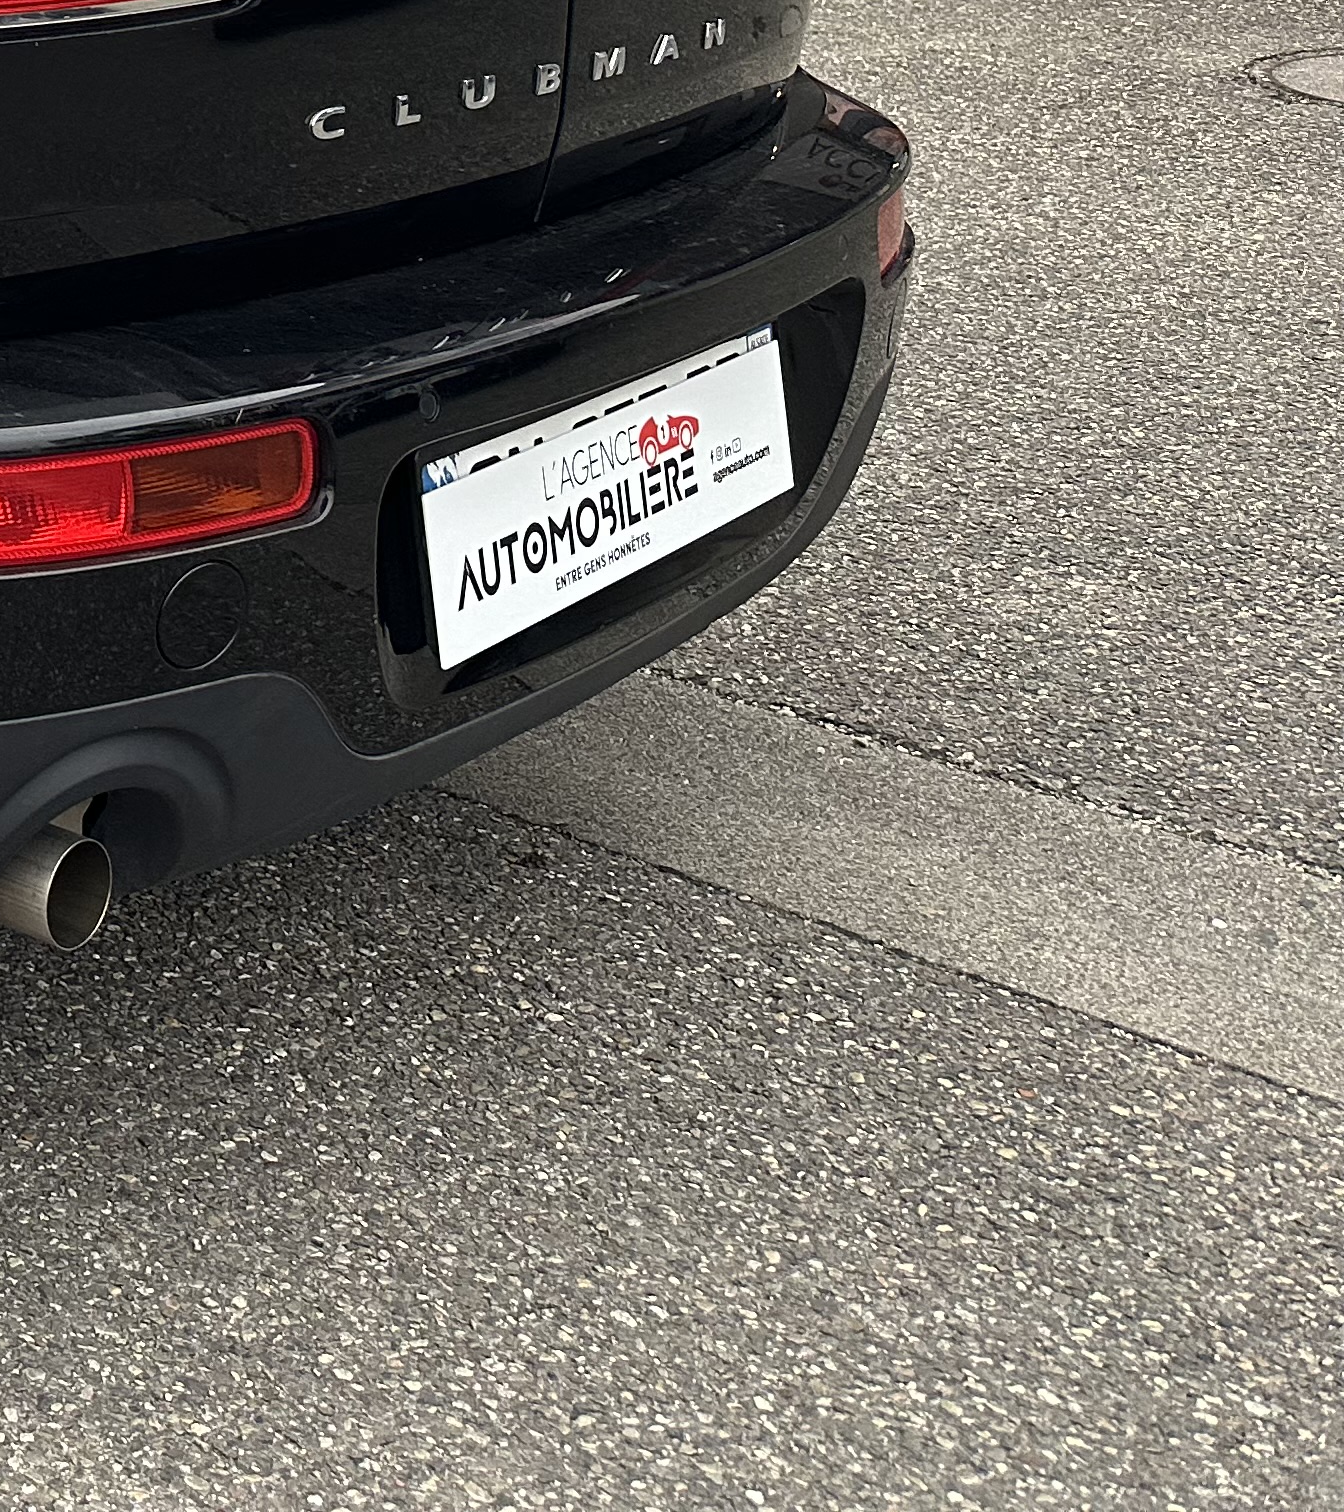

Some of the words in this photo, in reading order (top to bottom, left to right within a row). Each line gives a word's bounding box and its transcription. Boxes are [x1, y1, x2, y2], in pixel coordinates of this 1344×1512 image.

[306, 17, 727, 140] CLUBMAN
[541, 424, 640, 501] L'AGENCE
[555, 568, 582, 591] ENTRE
[584, 555, 607, 577] GENS
